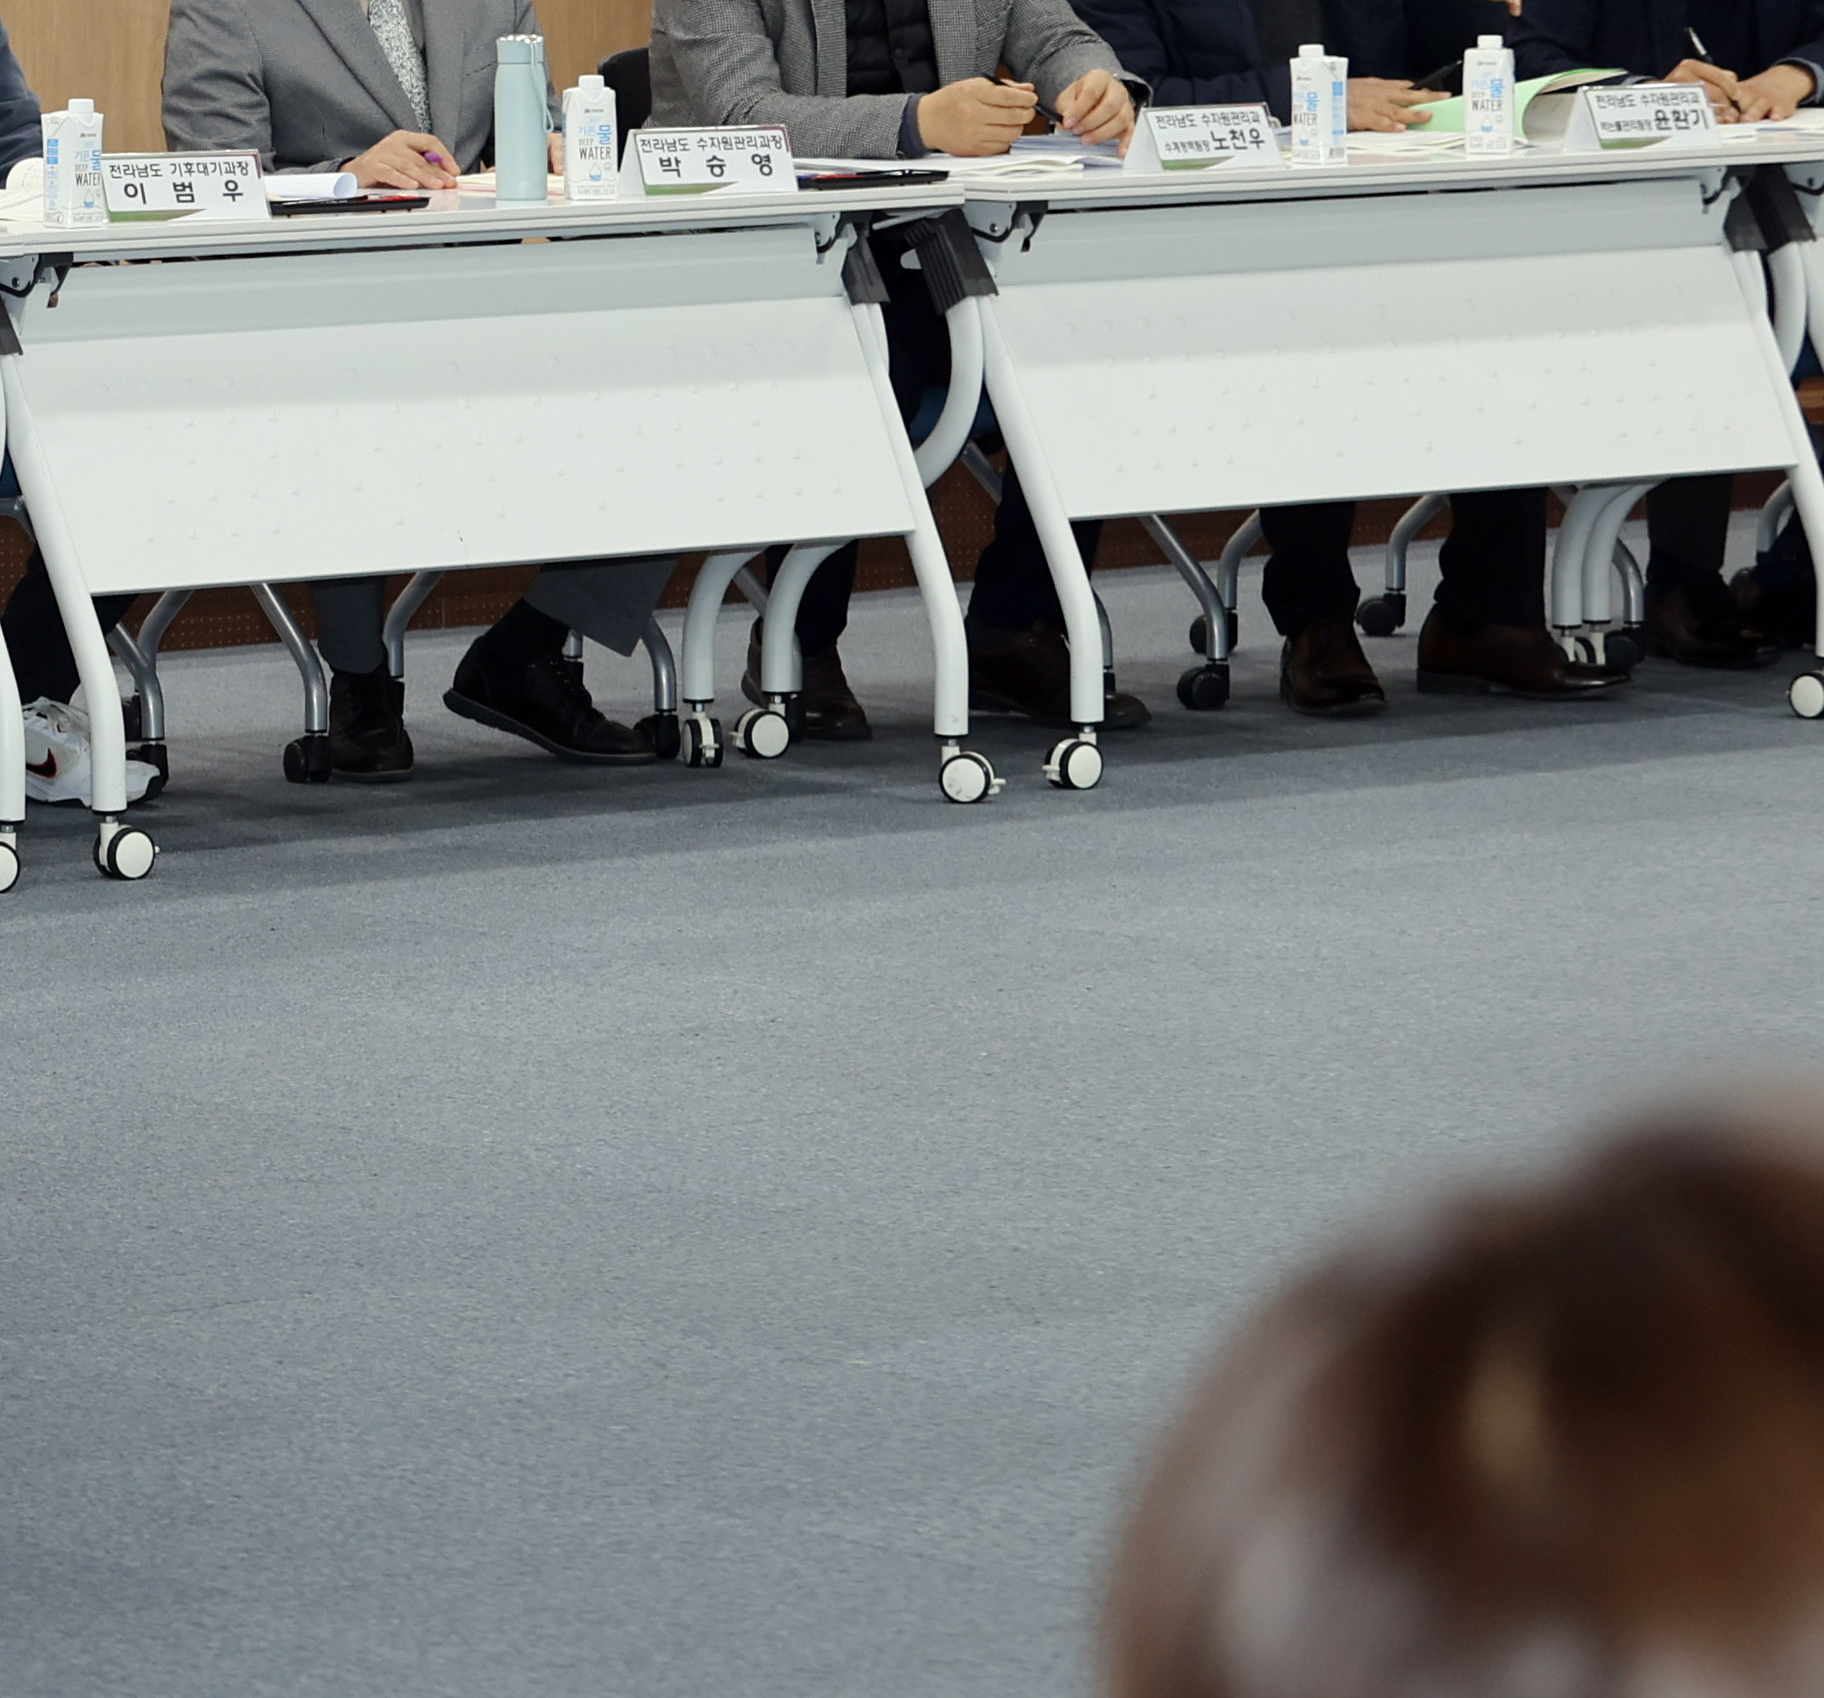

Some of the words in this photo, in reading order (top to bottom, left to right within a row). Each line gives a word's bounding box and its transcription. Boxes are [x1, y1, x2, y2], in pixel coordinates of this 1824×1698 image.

[1472, 99, 1503, 112] WATER
[1155, 113, 1198, 129] 전라남도
[1201, 110, 1261, 126] 수자원관리과
[579, 146, 611, 160] WATER
[640, 137, 691, 153] 전라남도
[696, 134, 783, 151] 수자원관리과장
[109, 163, 163, 179] 전라남도
[169, 160, 249, 177] 기후대기과장
[659, 156, 681, 178] 박
[706, 155, 727, 178] 승
[751, 153, 773, 177] 영
[123, 182, 147, 205] 이
[172, 181, 195, 204] 범
[222, 179, 244, 203] 우
